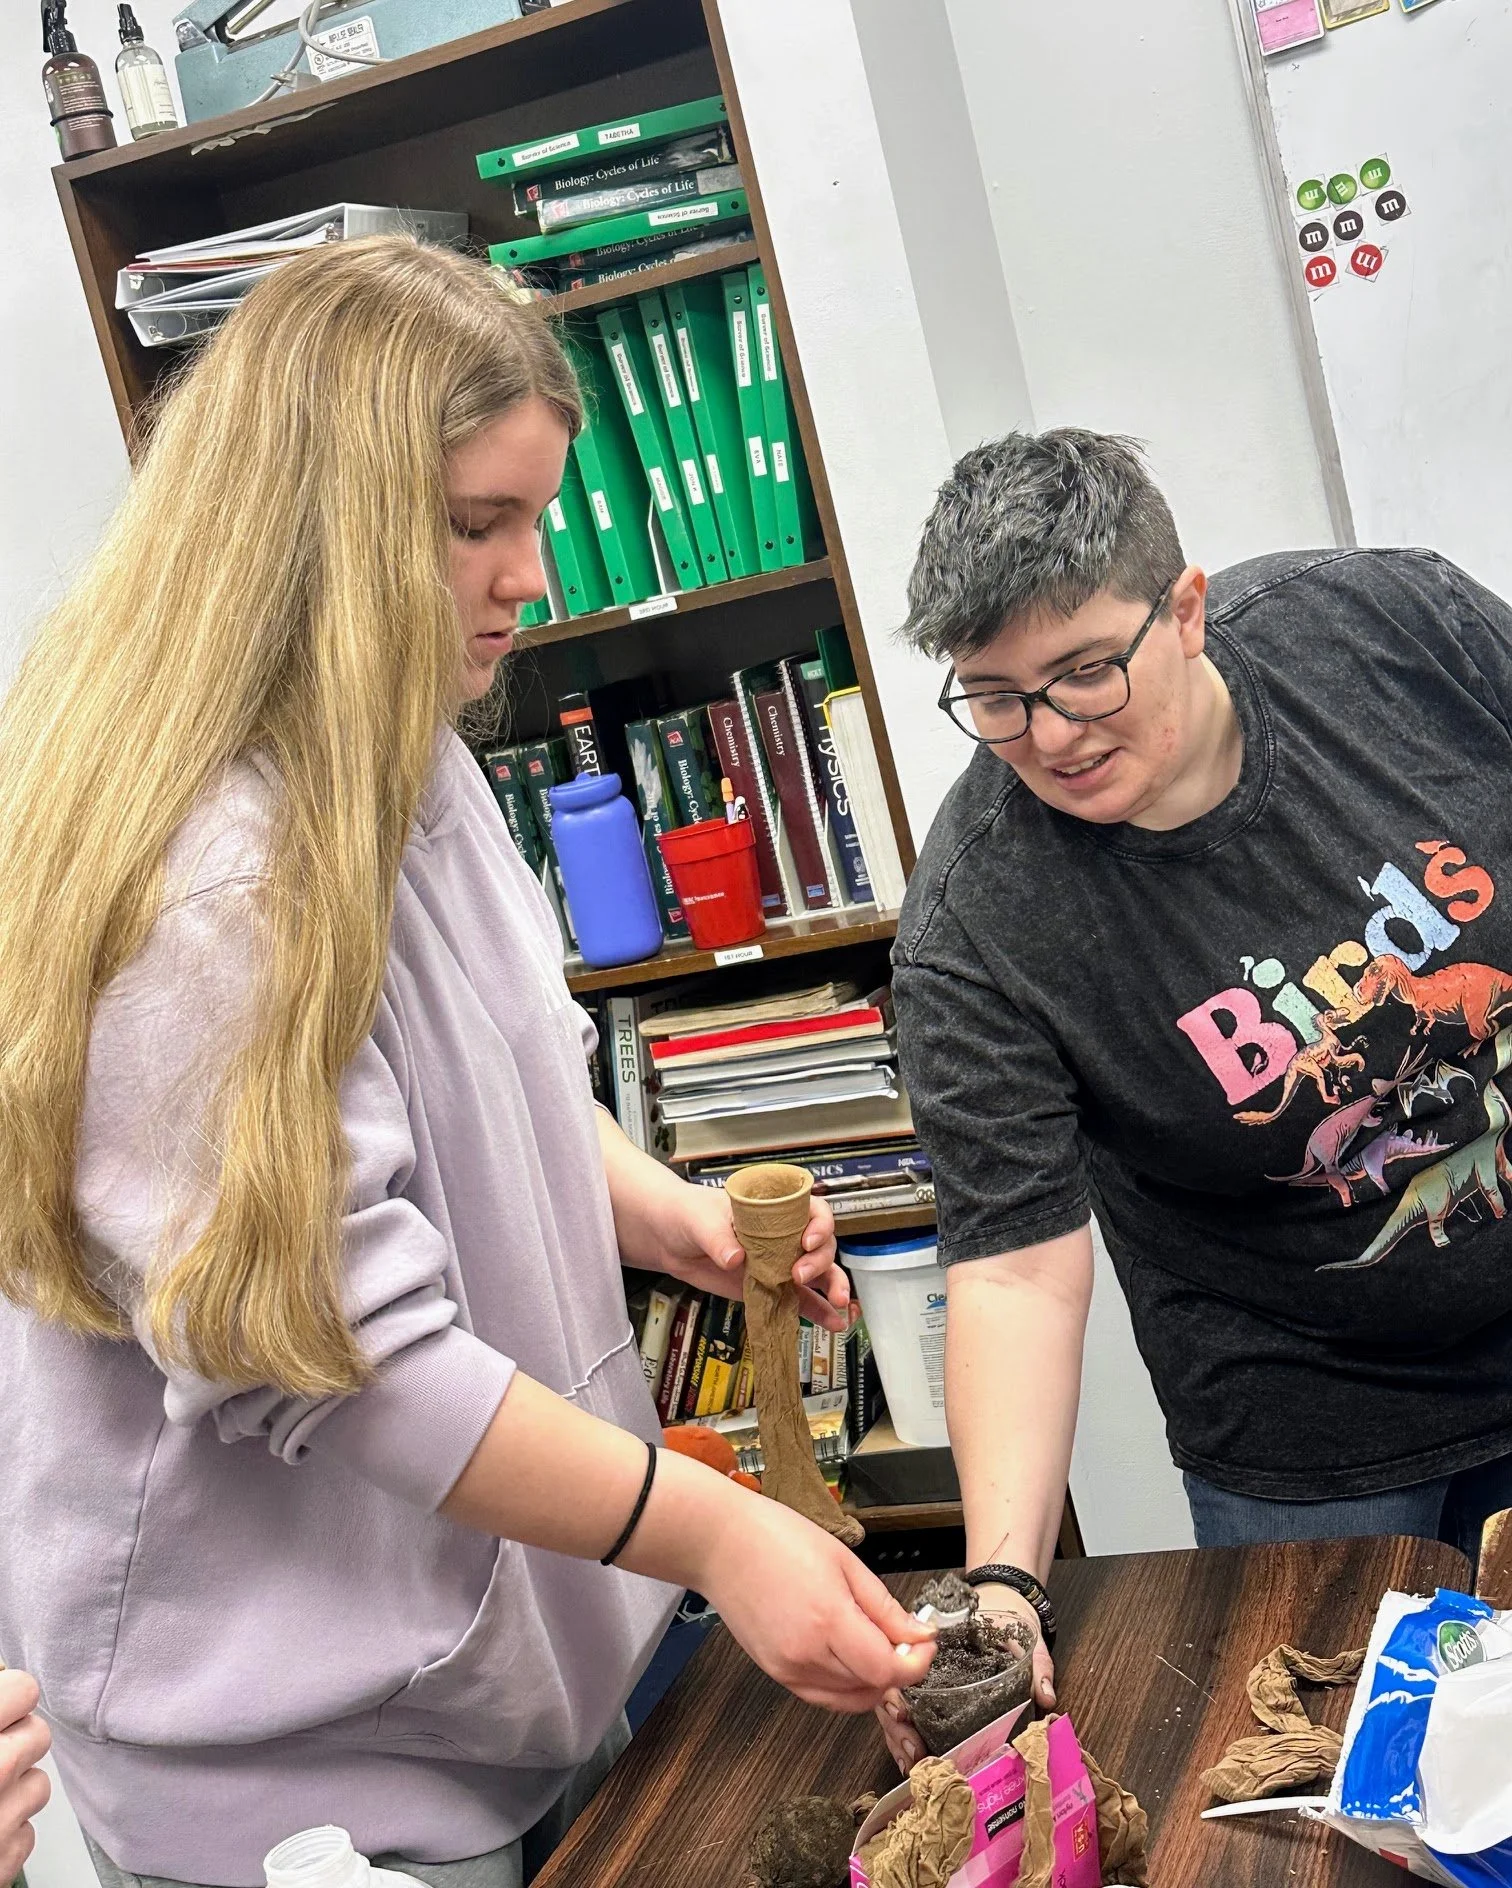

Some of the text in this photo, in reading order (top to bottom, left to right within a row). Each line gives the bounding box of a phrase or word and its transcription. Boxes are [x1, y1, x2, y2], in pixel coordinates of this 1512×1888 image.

[554, 155, 660, 191] Biology: Cycles of Life
[582, 179, 695, 210] Biology: Cycles of Life
[1381, 197, 1400, 213] m
[1305, 229, 1323, 244] m
[1339, 217, 1357, 234] m
[1309, 261, 1332, 281] m
[753, 449, 761, 464] EVA
[574, 724, 602, 776] EART
[723, 716, 741, 768] Chemistry
[767, 705, 785, 756] Chemistry
[677, 759, 702, 825] Biology: Cycl
[504, 793, 520, 833] Biology:
[1176, 841, 1495, 1106] Birds
[617, 1014, 636, 1083] TREES
[1443, 1630, 1477, 1669] Scotts
